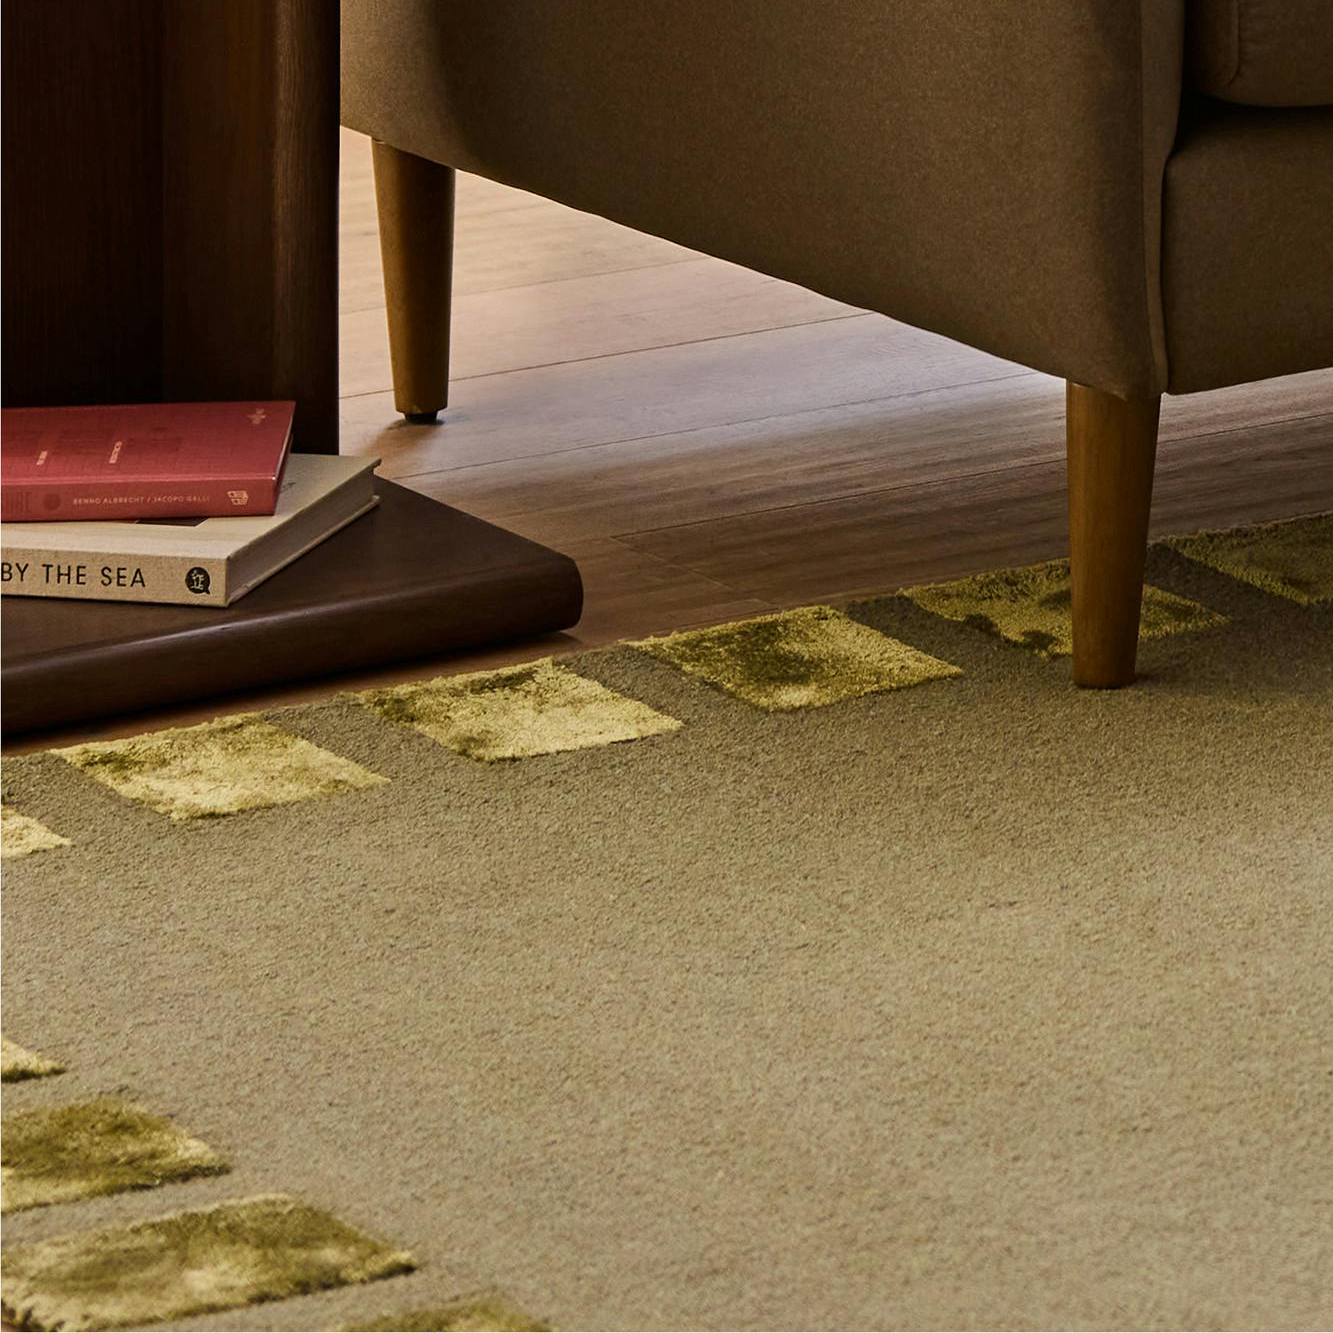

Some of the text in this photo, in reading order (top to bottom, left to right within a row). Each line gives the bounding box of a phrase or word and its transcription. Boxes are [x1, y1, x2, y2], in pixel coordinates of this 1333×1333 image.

[73, 496, 101, 505] BENNO
[102, 495, 144, 505] ALBRECHT
[1, 562, 146, 587] BY THE SEA
